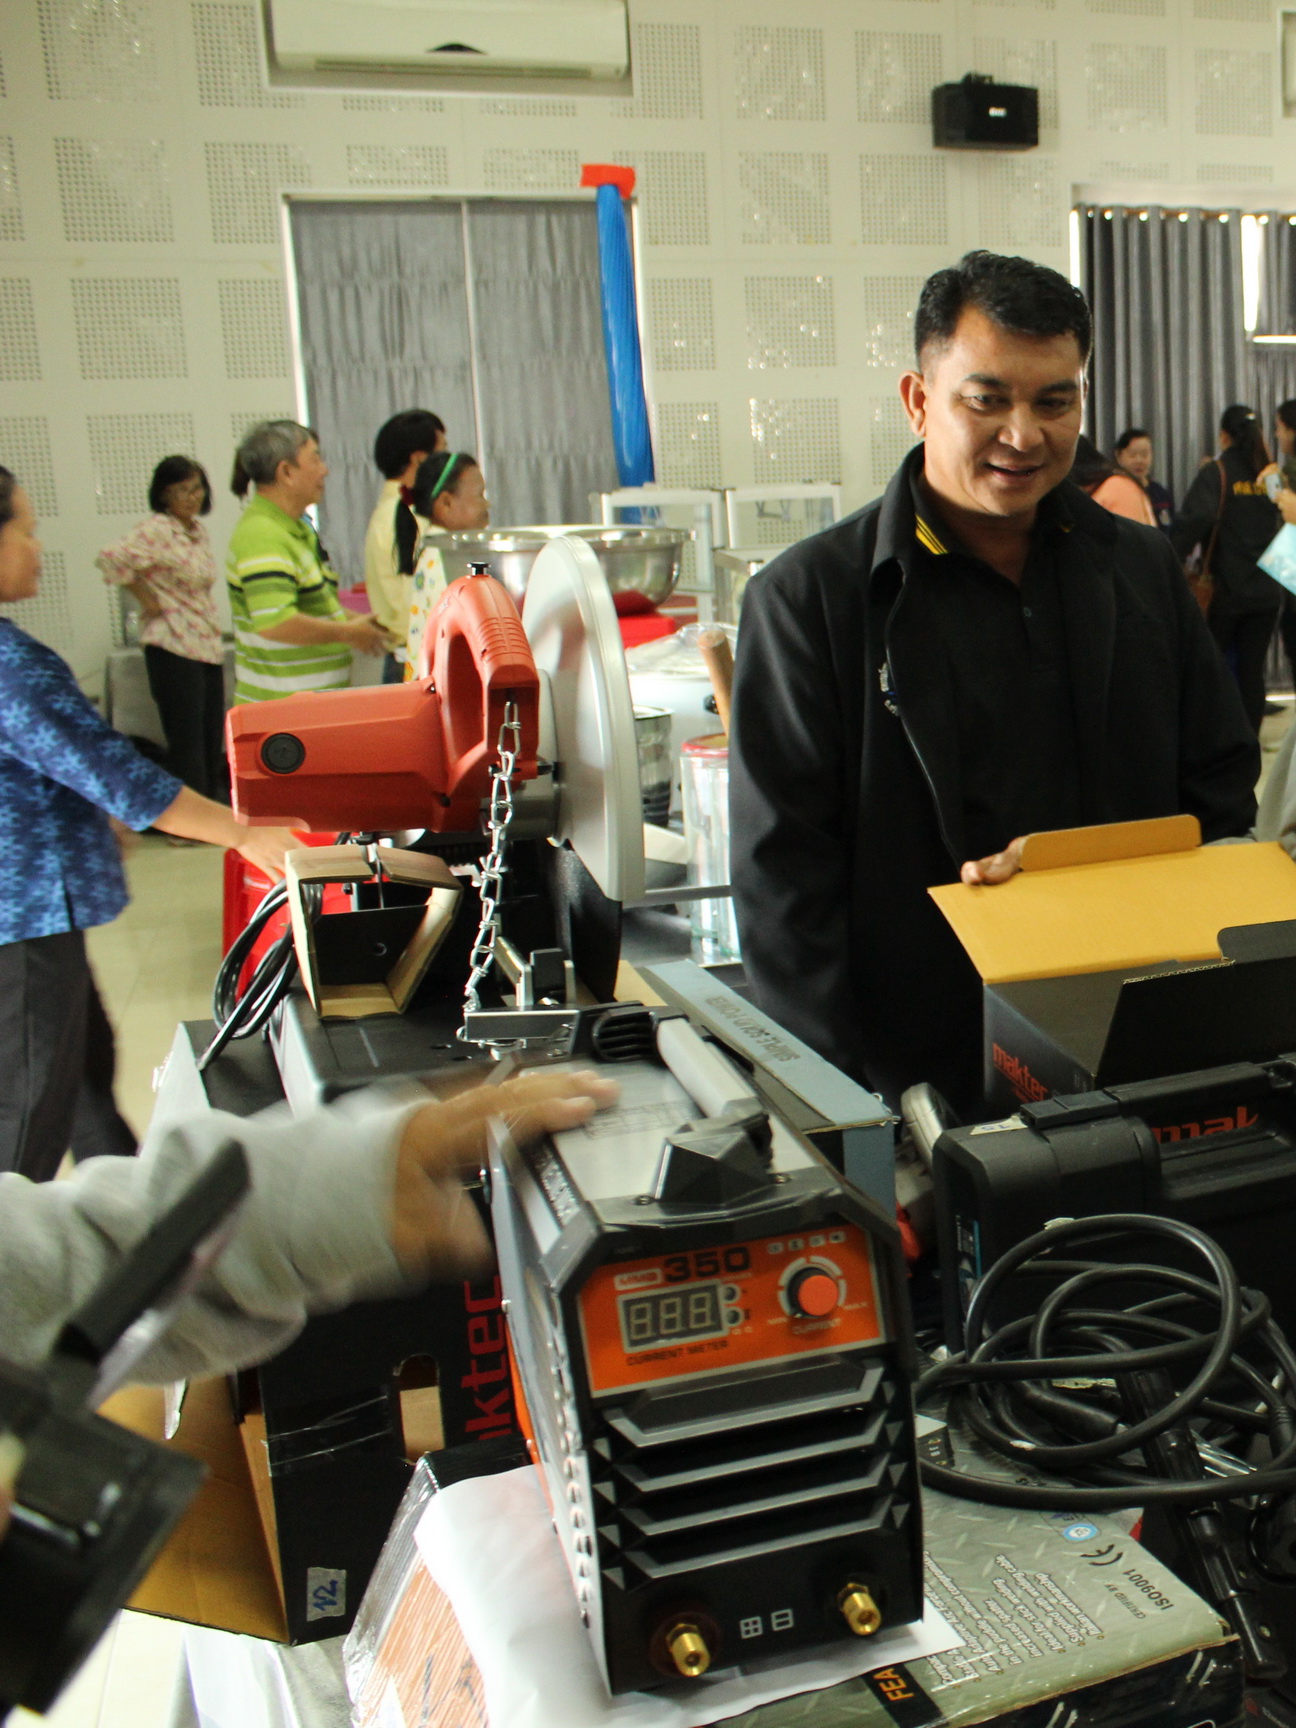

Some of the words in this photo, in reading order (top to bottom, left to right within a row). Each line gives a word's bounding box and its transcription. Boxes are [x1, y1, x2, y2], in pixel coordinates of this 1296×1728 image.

[664, 1246, 751, 1283] 350
[626, 1347, 683, 1366] CURRENT
[688, 1339, 729, 1354] METER
[1012, 1572, 1042, 1598] welding
[1034, 1572, 1082, 1615] workmanship
[1104, 1583, 1118, 1592] BY
[1122, 1569, 1174, 1611] ISO9001
[942, 1610, 960, 1623] Arc
[953, 1594, 983, 1620] without
[1014, 1604, 1038, 1622] stick
[1035, 1598, 1056, 1613] with
[1114, 1592, 1146, 1619] CERTIFIED
[976, 1619, 1007, 1643] puddle
[1046, 1611, 1084, 1644] Supplied
[1075, 1613, 1103, 1636] Italian
[954, 1623, 985, 1654] Adaptive
[998, 1643, 1016, 1656] the
[1003, 1622, 1044, 1658] increased
[1038, 1631, 1065, 1651] Ideal
[1010, 1655, 1023, 1665] in
[873, 1668, 914, 1701] FEA
